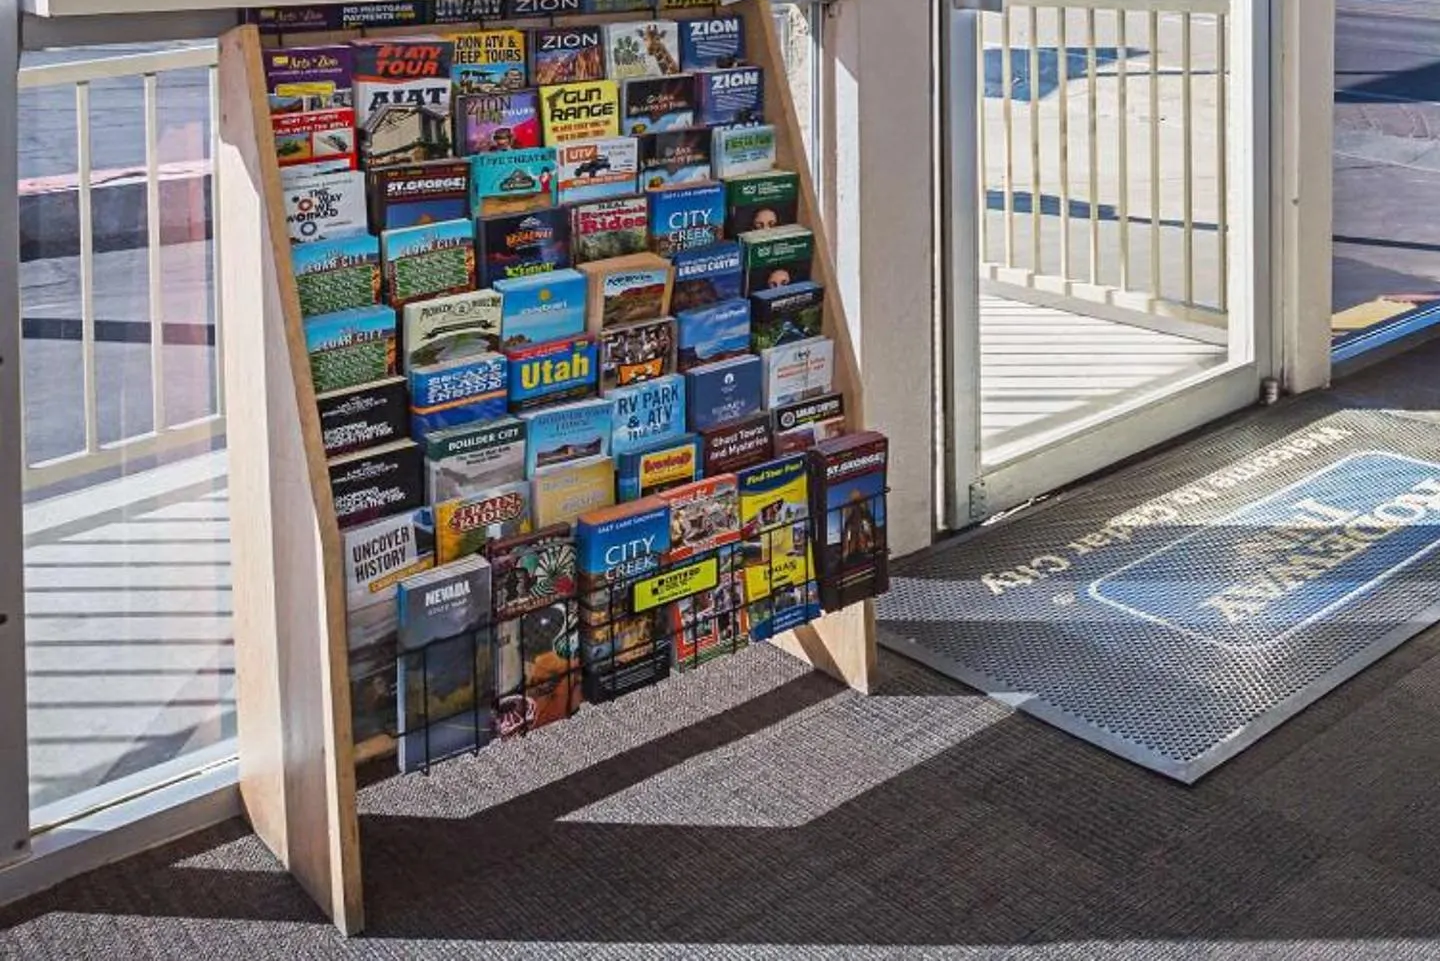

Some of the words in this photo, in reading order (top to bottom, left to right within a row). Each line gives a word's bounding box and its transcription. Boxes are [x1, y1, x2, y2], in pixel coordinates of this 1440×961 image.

[690, 19, 738, 36] ZION
[456, 36, 481, 50] ZION
[485, 35, 505, 49] ATV
[542, 33, 598, 50] ZION
[376, 59, 438, 76] TOUR
[455, 50, 481, 65] JEEP
[485, 48, 521, 63] TOURS
[711, 71, 759, 90] ZION
[563, 87, 601, 104] GUN
[551, 102, 615, 122] RANGE
[568, 147, 596, 161] UTV
[581, 214, 646, 236] Rides
[668, 207, 713, 230] CITY
[668, 227, 711, 243] CREEK
[520, 353, 590, 390] Utah
[618, 396, 638, 416] RV
[642, 383, 679, 410] PARK
[627, 415, 640, 429] &
[648, 404, 673, 425] ATV
[1206, 425, 1354, 491] Welcome
[460, 495, 520, 518] TRAIN
[352, 526, 410, 563] UNCOVER
[605, 534, 656, 566] CITY
[355, 547, 408, 583] HISTORY
[605, 556, 657, 581] CREEK
[980, 548, 1070, 598] City
[425, 580, 471, 607] NEVADA
